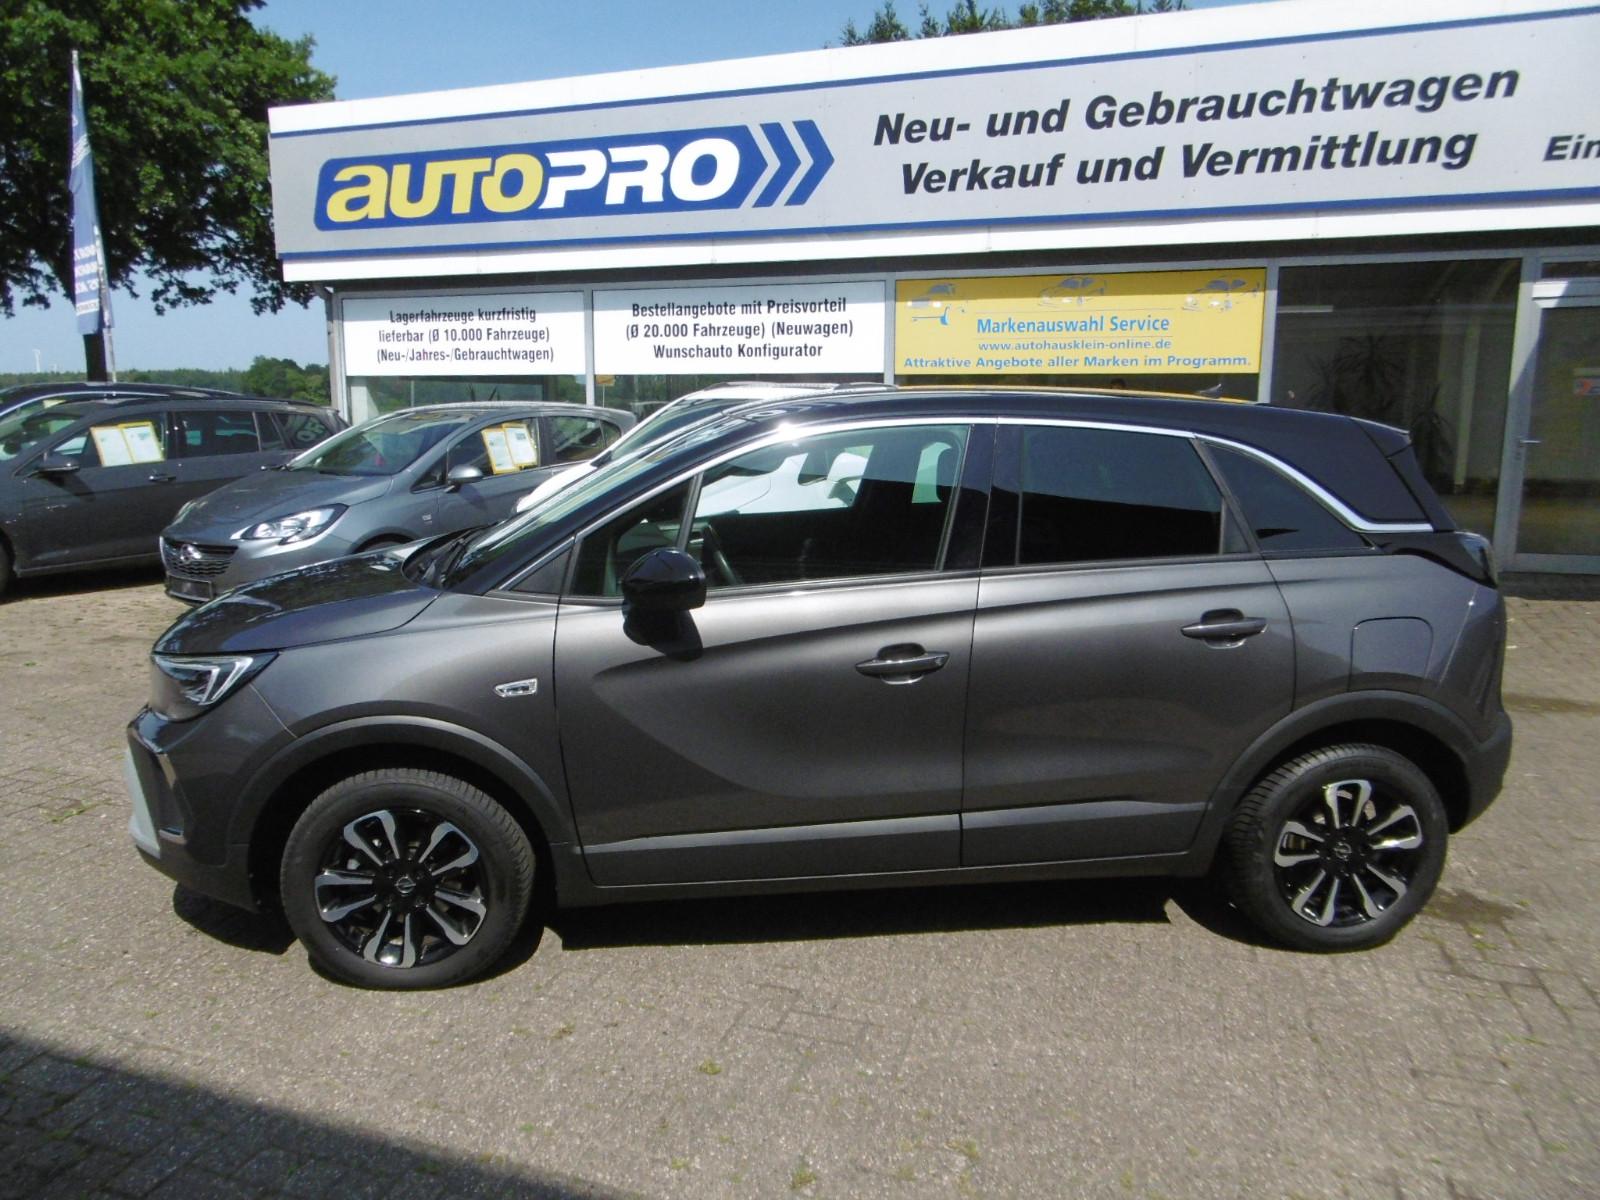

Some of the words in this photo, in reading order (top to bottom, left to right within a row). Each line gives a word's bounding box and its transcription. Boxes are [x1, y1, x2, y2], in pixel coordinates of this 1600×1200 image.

[873, 113, 970, 146] Neu-
[985, 99, 1071, 137] und
[1085, 69, 1520, 130] Gebrauchtwagen
[902, 153, 1066, 194] Verkauf
[1076, 146, 1165, 185] und
[1182, 131, 1478, 178] Vermittlung
[389, 309, 474, 325] Lagerfahrzeuge
[477, 307, 536, 323] kurzfristig
[632, 302, 736, 319] Bestellangebote
[741, 300, 762, 315] mit
[767, 297, 846, 314] Preisvorteil
[644, 323, 688, 338] 20.000
[693, 321, 766, 339] Fahrzeuge)
[771, 319, 854, 338] (Neuwagen)
[976, 316, 1104, 335] Markenauswahl
[1110, 315, 1170, 332] Service
[379, 329, 424, 343] lieferbar
[444, 328, 482, 341] 10.000
[486, 327, 550, 343] Fahrzeuge)
[978, 338, 1172, 351] www.autohausklein-online.de
[653, 344, 733, 359] Wunschauto
[738, 343, 823, 360] Konfigurator
[904, 356, 971, 368] Attraktive
[975, 355, 1043, 370] Angebote
[1047, 355, 1080, 367] aller
[1083, 355, 1139, 367] Marken
[1144, 355, 1162, 367] im
